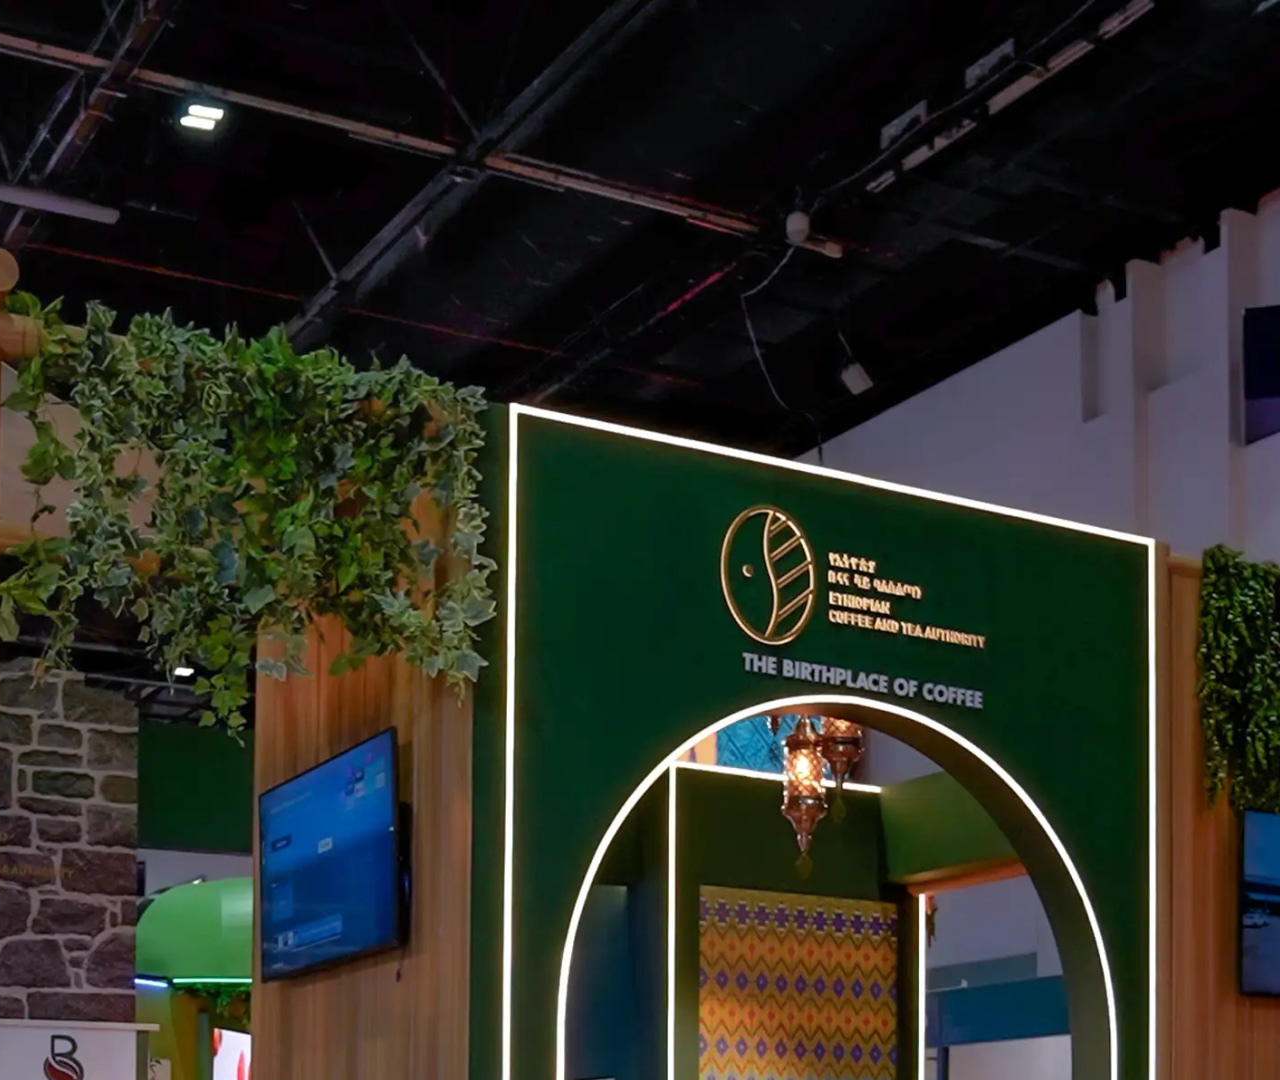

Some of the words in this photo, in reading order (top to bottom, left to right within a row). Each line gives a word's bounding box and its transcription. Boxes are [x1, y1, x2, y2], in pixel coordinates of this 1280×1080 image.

[828, 591, 891, 615] ETHIOPIAN
[828, 610, 874, 629] COFFEE
[874, 617, 900, 634] AND
[901, 621, 924, 638] TEA
[924, 625, 986, 648] AUTHORITY
[742, 652, 777, 675] THE
[782, 659, 888, 693] BIRTHPLACE
[893, 678, 918, 697] OF
[922, 683, 984, 709] COFFEE
